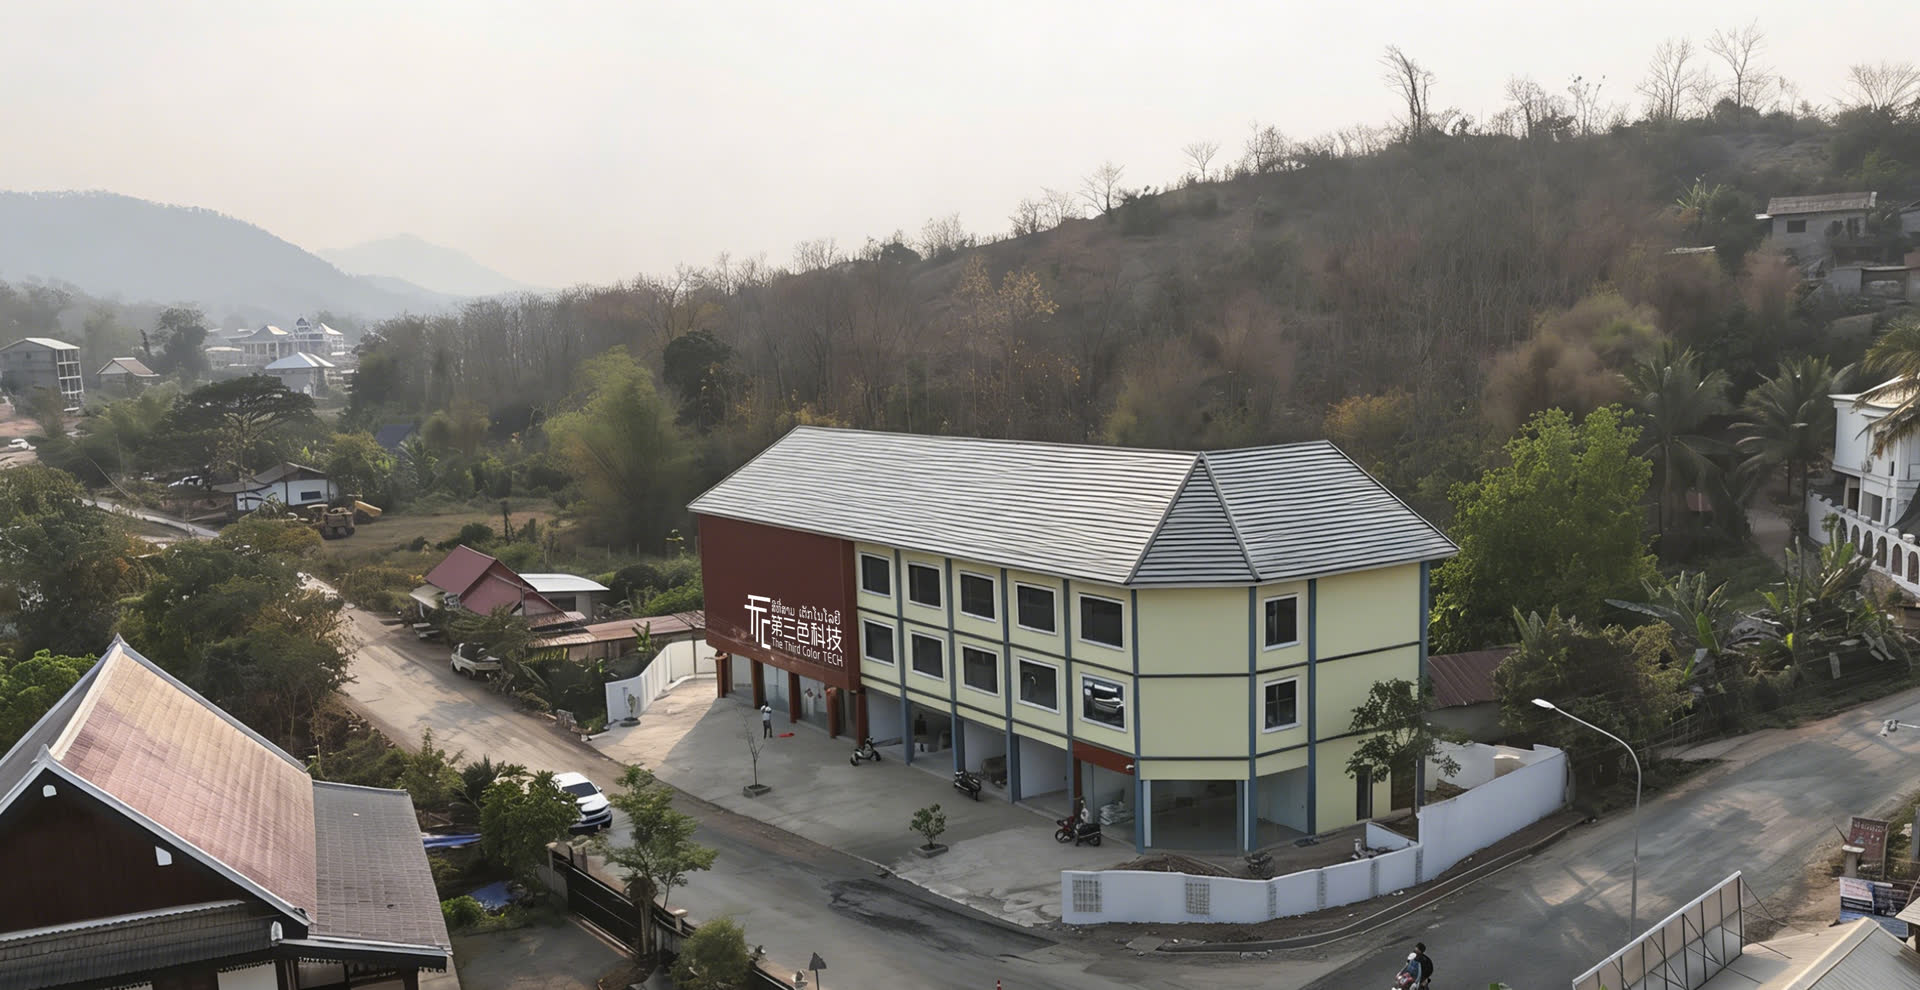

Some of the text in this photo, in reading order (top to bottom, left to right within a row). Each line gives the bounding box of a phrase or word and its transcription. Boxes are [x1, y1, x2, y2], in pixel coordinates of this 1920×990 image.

[771, 615, 843, 653] 第三色科技
[771, 637, 844, 668] The Third Color TECH
